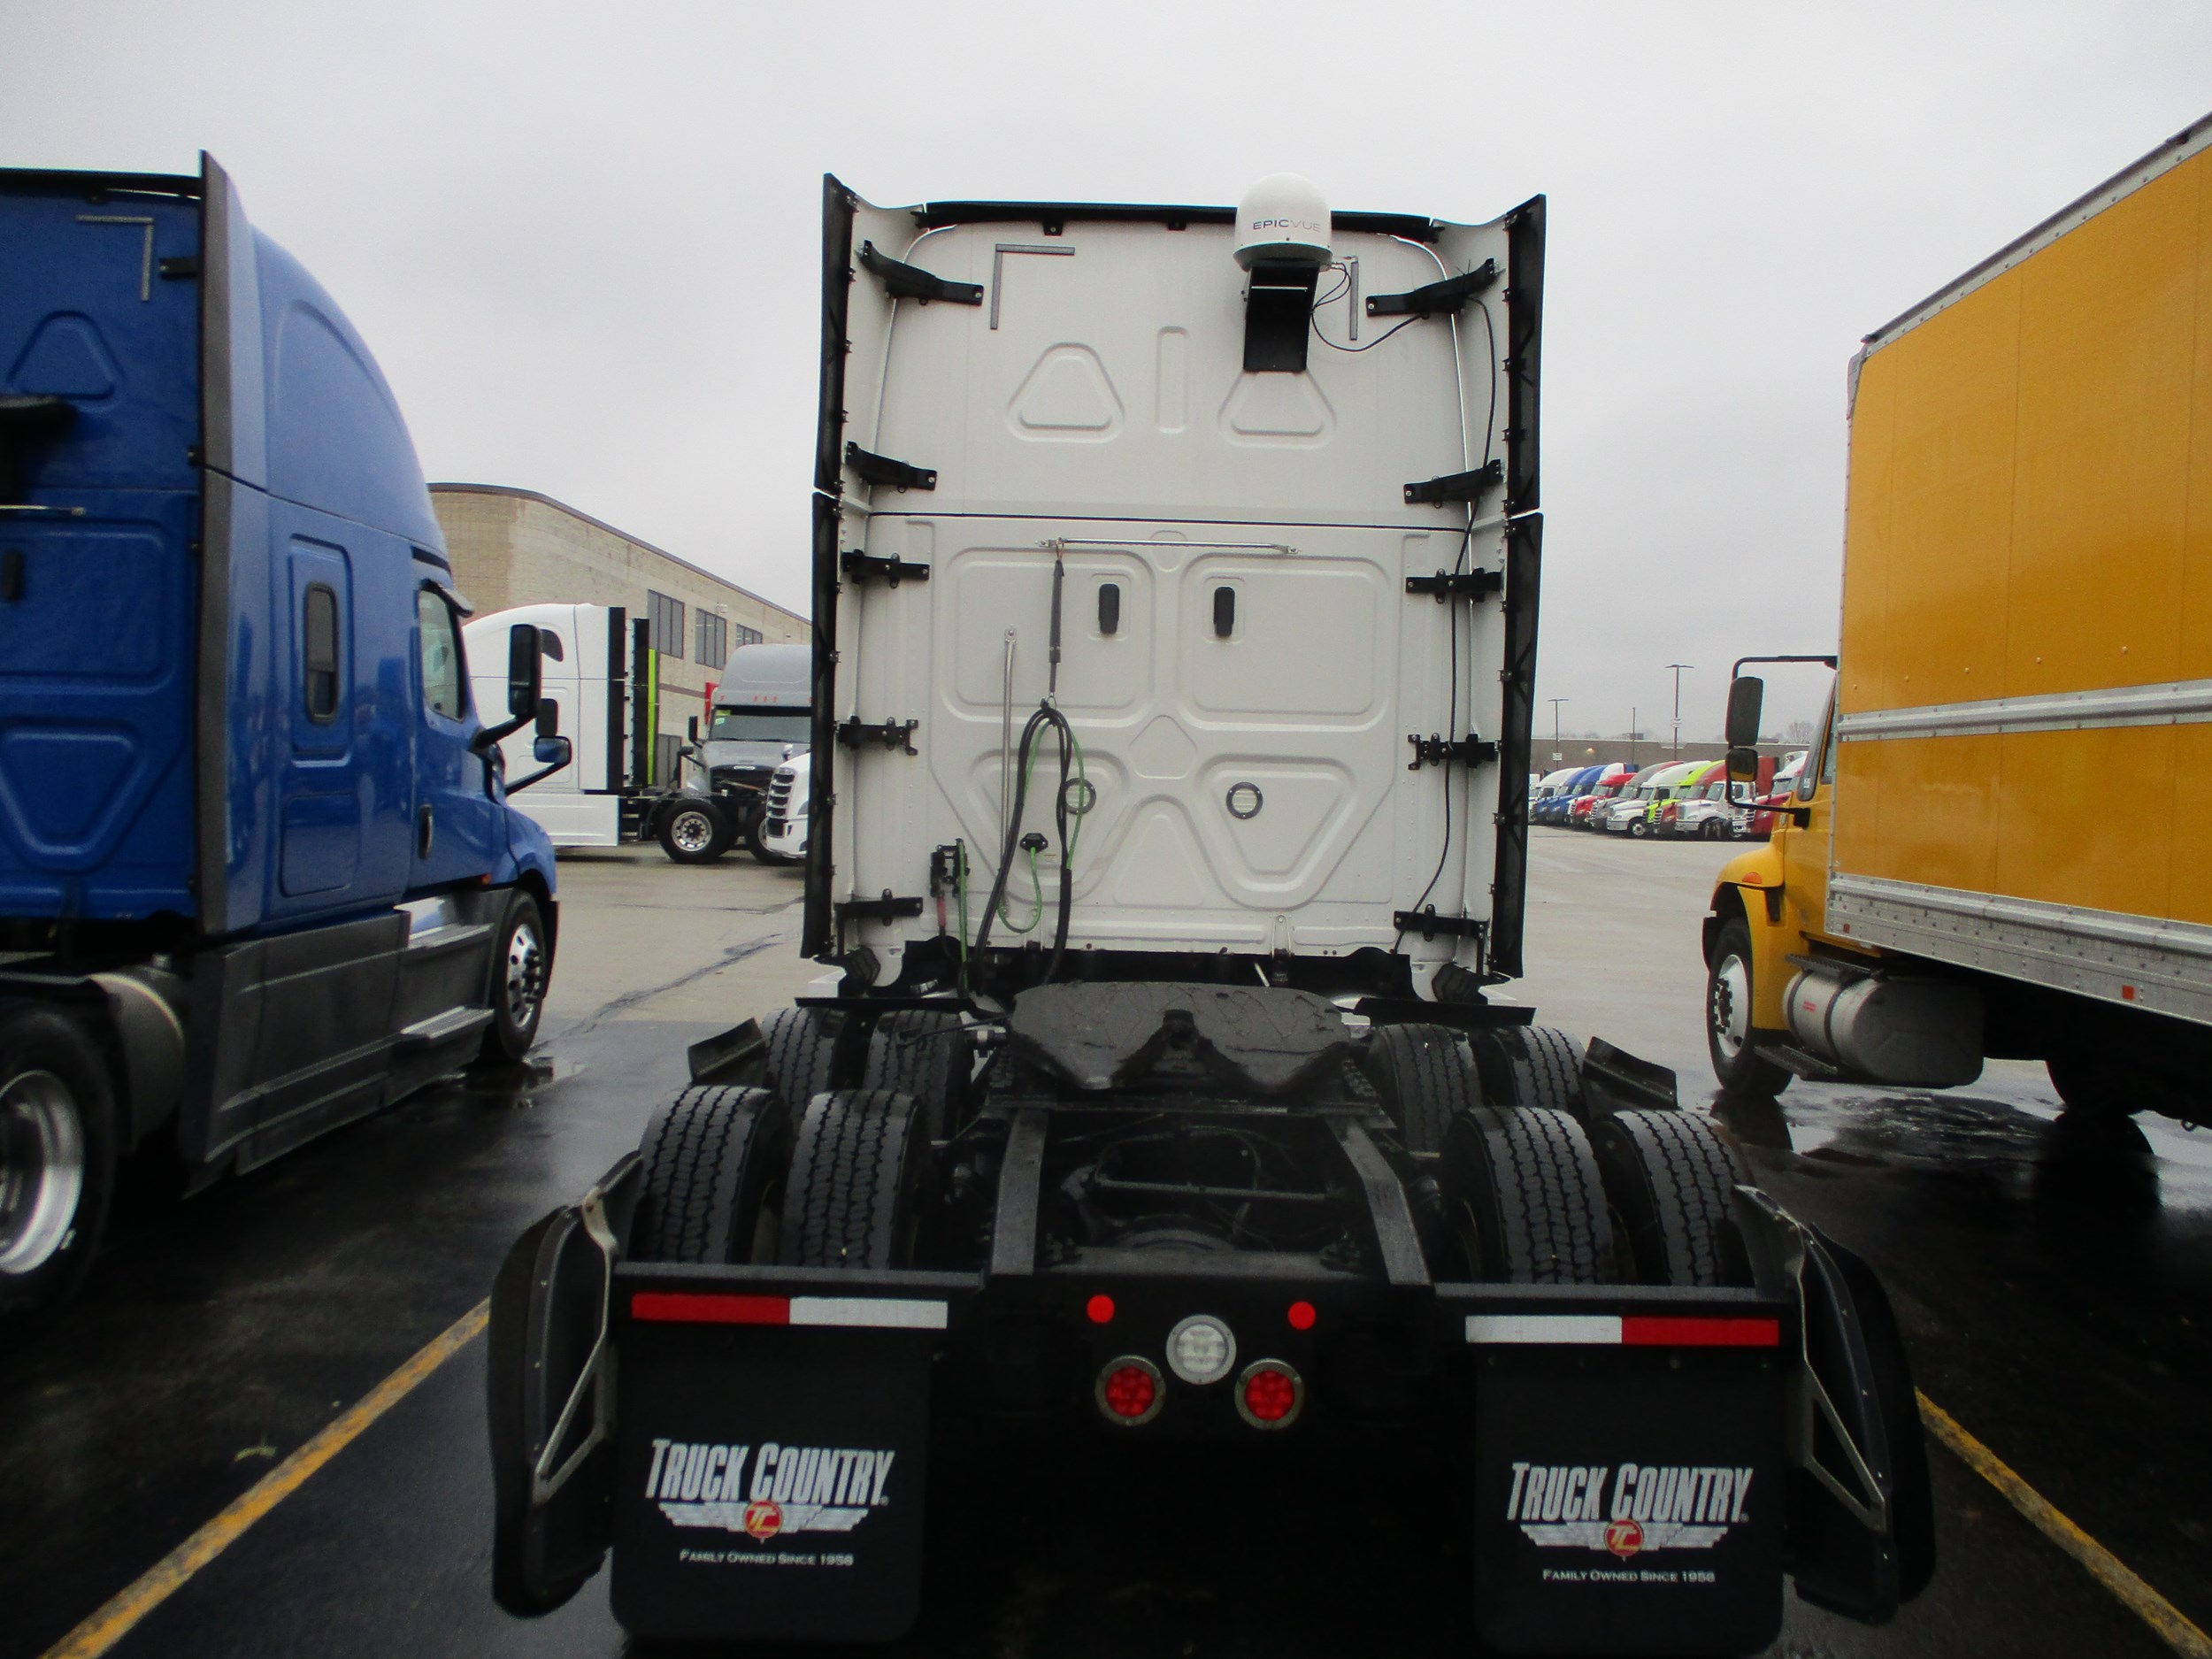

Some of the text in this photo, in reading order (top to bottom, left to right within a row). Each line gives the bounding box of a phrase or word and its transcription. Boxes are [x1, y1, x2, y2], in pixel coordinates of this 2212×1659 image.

[1252, 219, 1321, 233] EPICVUE
[645, 1438, 895, 1506] TRUCK COUNTRY
[1507, 1462, 1754, 1524] TRUCK COUNTRY
